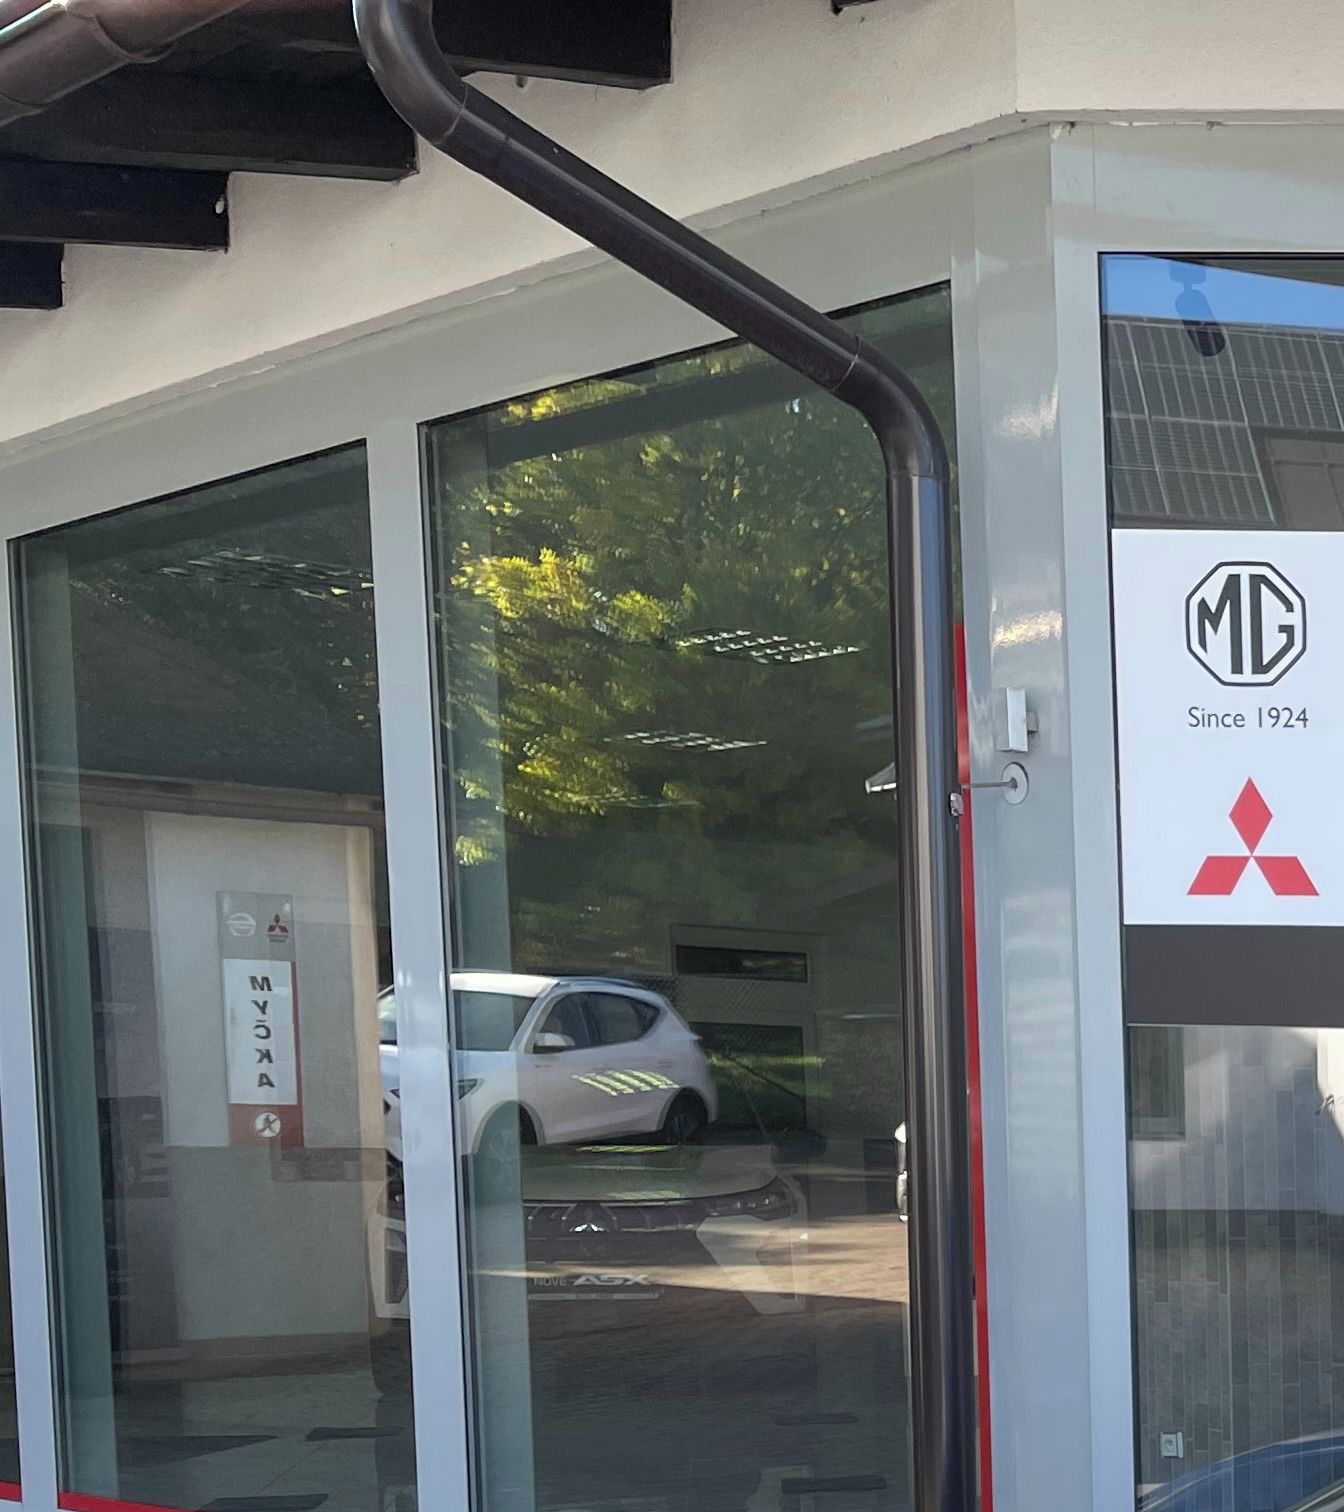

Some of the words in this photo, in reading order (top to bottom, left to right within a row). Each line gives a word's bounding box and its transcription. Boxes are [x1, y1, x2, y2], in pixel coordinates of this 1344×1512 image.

[1193, 568, 1301, 680] MG
[1187, 706, 1245, 729] Since
[1254, 706, 1309, 730] 1924
[573, 1274, 650, 1286] ASX
